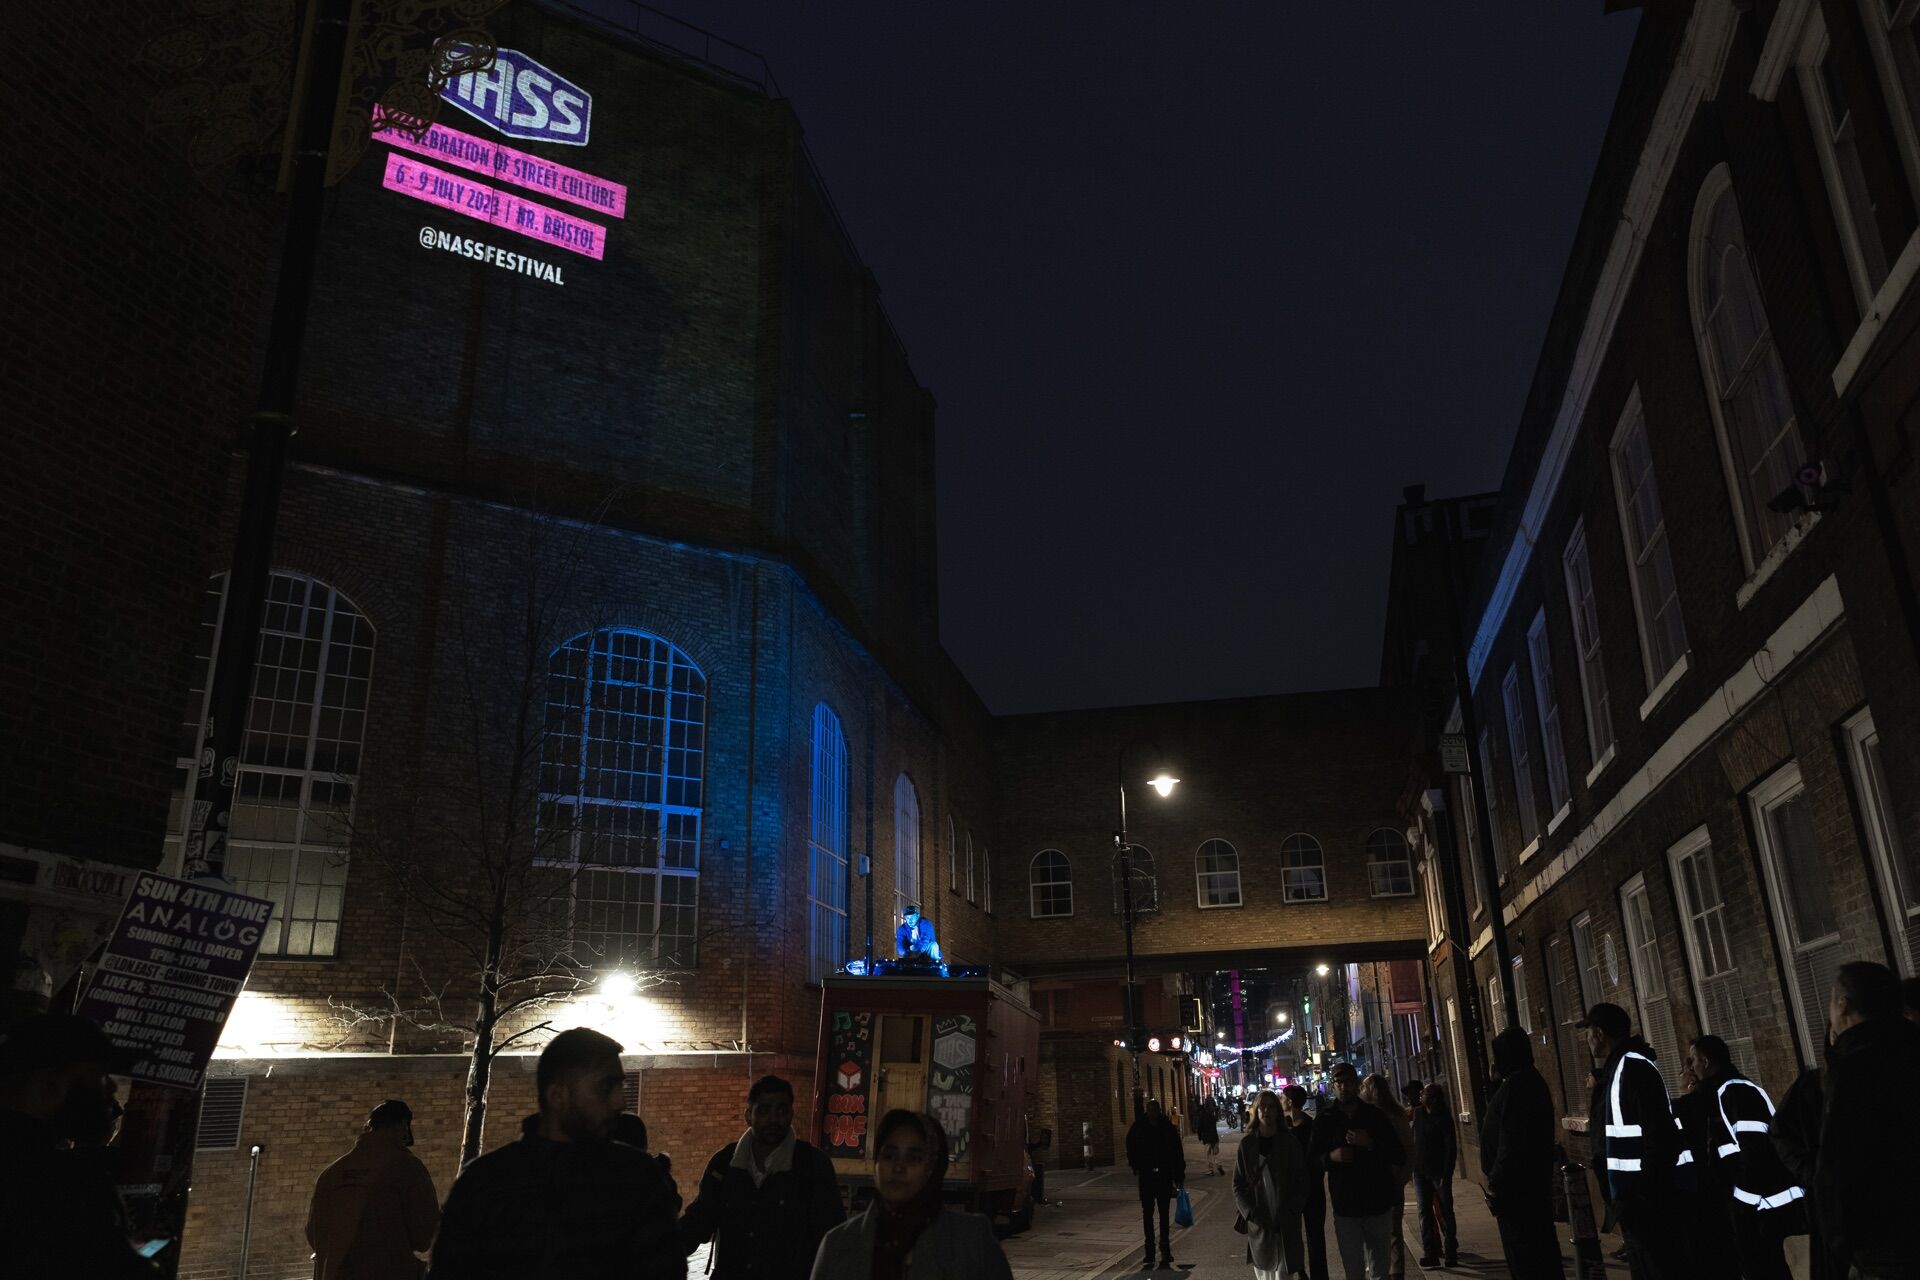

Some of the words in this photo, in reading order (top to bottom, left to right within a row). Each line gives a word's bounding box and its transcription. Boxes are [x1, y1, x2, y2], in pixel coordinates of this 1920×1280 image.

[493, 153, 512, 173] OF
[513, 157, 560, 190] STREET
[561, 174, 617, 210] CULTURE
[395, 163, 405, 184] 6
[419, 171, 428, 191] 9
[431, 175, 465, 204] JULY
[466, 188, 499, 217] 2023
[517, 205, 539, 231] NR.
[543, 215, 595, 251] BRISTOL
[419, 226, 565, 286] @NASSFESTIVAL
[137, 877, 181, 903] SUN
[181, 888, 222, 913] 4TH
[219, 896, 270, 924] JUNE
[126, 901, 259, 946] ANALOG
[127, 926, 183, 949] SUMMER
[182, 938, 204, 953] ALL
[204, 943, 245, 961] DAYER
[149, 948, 211, 970] 1PM-11PM
[102, 974, 130, 990] LIVE
[208, 977, 240, 994] TOWN
[102, 1020, 132, 1036] SAM
[129, 1026, 186, 1047] SUPPLIER
[115, 1007, 144, 1023] WILL
[144, 1012, 187, 1031] TAYLOR
